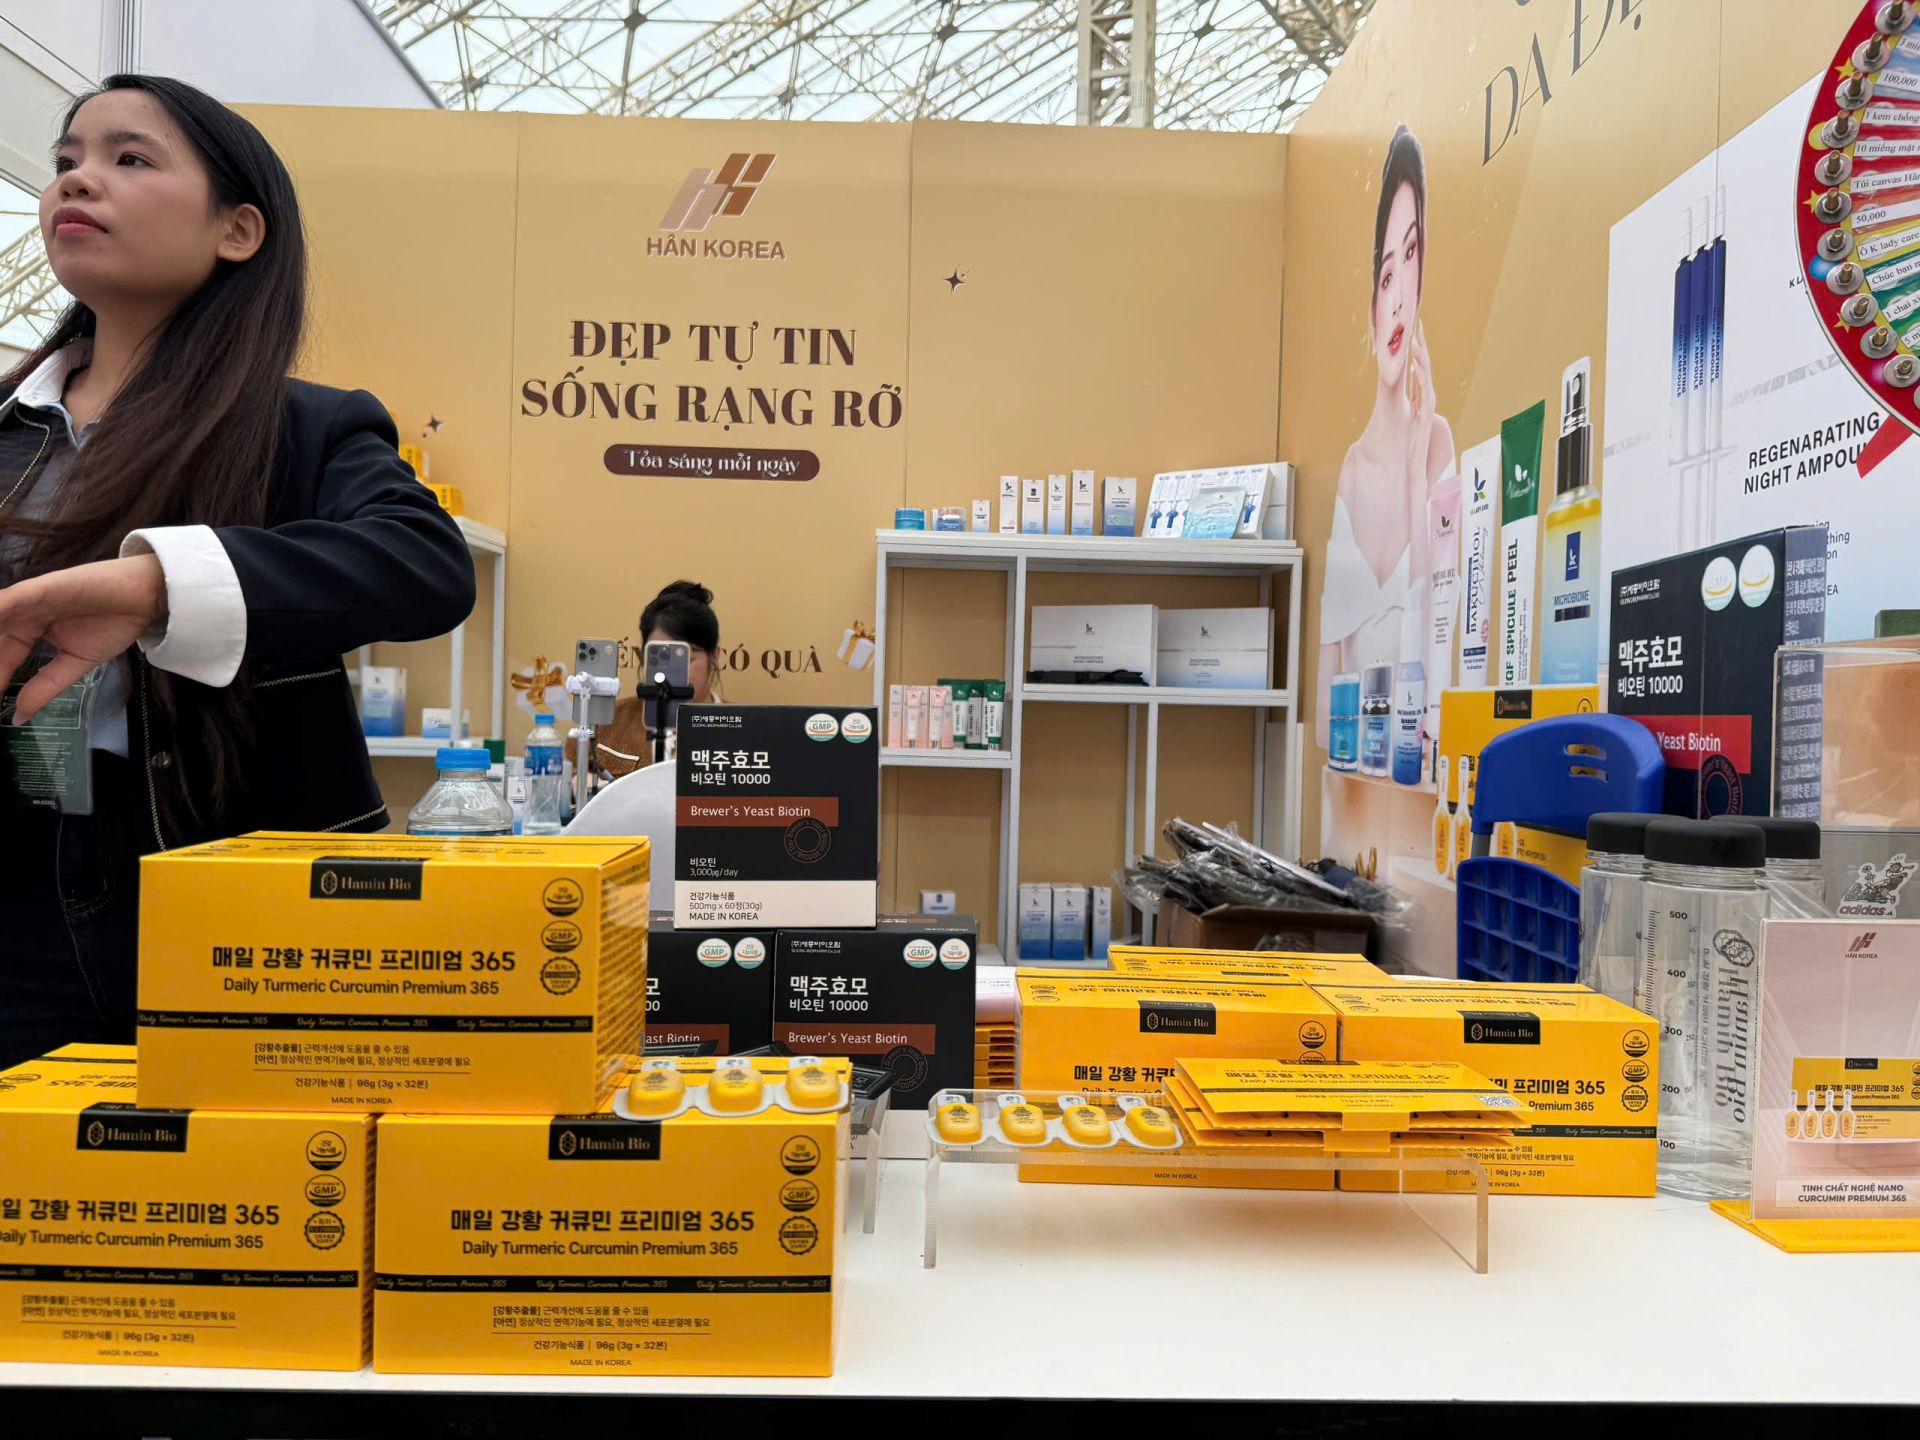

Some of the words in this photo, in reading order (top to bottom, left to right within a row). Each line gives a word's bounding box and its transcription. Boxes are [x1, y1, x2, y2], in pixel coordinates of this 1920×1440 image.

[1884, 73, 1917, 87] 100,000
[1483, 32, 1552, 166] DA
[1872, 113, 1890, 121] kem
[1893, 110, 1919, 123] chống
[1856, 144, 1867, 152] 10
[1869, 141, 1896, 154] miếng
[1899, 142, 1915, 154] mặt
[1855, 178, 1870, 190] Túi
[1872, 177, 1902, 188] canvas
[1856, 210, 1886, 224] 50,000
[704, 239, 786, 260] KOREA
[1860, 247, 1868, 257] Ô
[1870, 245, 1878, 253] K
[1880, 239, 1898, 252] lady
[1902, 234, 1919, 243] care
[1872, 273, 1894, 284] Chúc
[1897, 266, 1912, 279] bạn
[1893, 301, 1911, 315] chai
[569, 320, 671, 367] ĐẸP
[688, 320, 759, 370] TỰ
[773, 327, 857, 366] TIN
[521, 366, 657, 420] SỐNG
[676, 385, 814, 431] RẠNG
[831, 384, 902, 428] RỠ
[1749, 411, 1880, 470] REGENARATING
[624, 449, 663, 468] Tỏa
[668, 453, 713, 476] sáng
[718, 452, 752, 471] mỗi
[757, 458, 799, 478] ngày
[1743, 464, 1792, 495] NIGHT
[1796, 443, 1865, 480] AMPOU
[1506, 538, 1518, 583] PEEL
[1505, 589, 1517, 655] SPICULE
[761, 645, 822, 678] QUÀ
[1618, 635, 1683, 674] 맥주효모
[1618, 676, 1645, 698] 비오틴
[1648, 675, 1683, 694] 10000
[812, 723, 832, 731] GMP
[1657, 732, 1686, 750] Yeast
[1688, 732, 1721, 752] Biotin
[691, 750, 771, 771] 맥주효모
[691, 772, 726, 786] 비오틴
[731, 774, 771, 785] 10000
[690, 805, 740, 817] Brewer's
[743, 806, 774, 816] Yeast
[778, 805, 811, 817] Biotin
[689, 858, 716, 868] 비오틴
[341, 876, 386, 891] Hamin
[389, 876, 412, 891] Bio
[689, 892, 735, 901] 건강기능식품
[689, 902, 717, 911] 500mg
[724, 902, 762, 911] 60정(30g)
[1840, 905, 1886, 916] adidas
[1669, 911, 1688, 920] 500
[212, 946, 254, 969] 매일
[262, 947, 304, 970] 강황
[311, 949, 372, 970] 커큐민
[379, 950, 463, 972] 프리미엄
[470, 951, 516, 971] 365
[911, 949, 930, 957] GMP
[1667, 969, 1686, 979] 400
[224, 979, 259, 995] Daily
[263, 979, 326, 995] Turmeric
[330, 980, 400, 995] Curcumin
[402, 980, 467, 996] Premium
[469, 980, 499, 995] 365
[790, 976, 869, 997] 맥주효모
[789, 999, 824, 1012] 비오틴
[829, 1000, 869, 1011] 10000
[1717, 967, 1739, 1054] Hamin
[1160, 1017, 1191, 1028] Hamin
[1193, 1018, 1209, 1028] Bio
[788, 1032, 837, 1043] Brewer's
[841, 1033, 871, 1043] Yeast
[875, 1033, 908, 1044] Biotin
[1484, 1029, 1515, 1038] Hamin
[1517, 1029, 1534, 1038] Bio
[1664, 1026, 1683, 1036] 300
[1074, 1066, 1102, 1081] 매일
[1109, 1066, 1137, 1082] 강황
[1513, 1079, 1570, 1094] 프리미엄
[1575, 1080, 1606, 1095] 365
[1662, 1085, 1680, 1095] 200
[1529, 1101, 1572, 1112] Premium
[1574, 1101, 1594, 1111] 365
[107, 1129, 152, 1142] Hamin
[155, 1129, 177, 1142] Bio
[580, 1137, 625, 1151] Hamin
[627, 1137, 651, 1151] Bio
[1660, 1139, 1676, 1150] 100
[1802, 1184, 1823, 1192] TINH
[1824, 1182, 1849, 1192] CHẤT
[1850, 1184, 1876, 1194] NGHỆ
[1878, 1184, 1904, 1192] NANO
[788, 1191, 811, 1200] GMP
[1798, 1194, 1845, 1202] CURCUMIN
[1848, 1194, 1889, 1202] PREMIUM
[1891, 1194, 1907, 1202] 365
[29, 1199, 70, 1220] 강황
[77, 1201, 137, 1222] 커큐민
[145, 1203, 228, 1225] 프리미엄
[235, 1205, 280, 1225] 365
[451, 1210, 493, 1232] 매일
[501, 1210, 542, 1232] 강황
[550, 1210, 611, 1232] 커큐민
[619, 1210, 702, 1232] 프리미엄
[709, 1211, 755, 1231] 365
[31, 1230, 94, 1245] Turmeric
[96, 1232, 165, 1247] Curcumin
[168, 1234, 232, 1249] Premium
[234, 1235, 264, 1249] 365
[463, 1241, 497, 1257] Daily
[501, 1241, 566, 1256] Turmeric
[569, 1241, 640, 1256] Curcumin
[642, 1241, 707, 1256] Premium
[709, 1241, 738, 1256] 365
[586, 1306, 609, 1316] 도움을
[623, 1307, 631, 1315] 수
[633, 1306, 649, 1316] 있음
[519, 1318, 551, 1327] 정상적인
[553, 1318, 594, 1328] 면역기능에
[617, 1318, 649, 1328] 정상적인
[651, 1318, 692, 1328] 세포분열에
[694, 1318, 710, 1328] 필요
[534, 1341, 584, 1350] 건강기능식품
[596, 1341, 615, 1351] 96g
[617, 1341, 633, 1351] (3g
